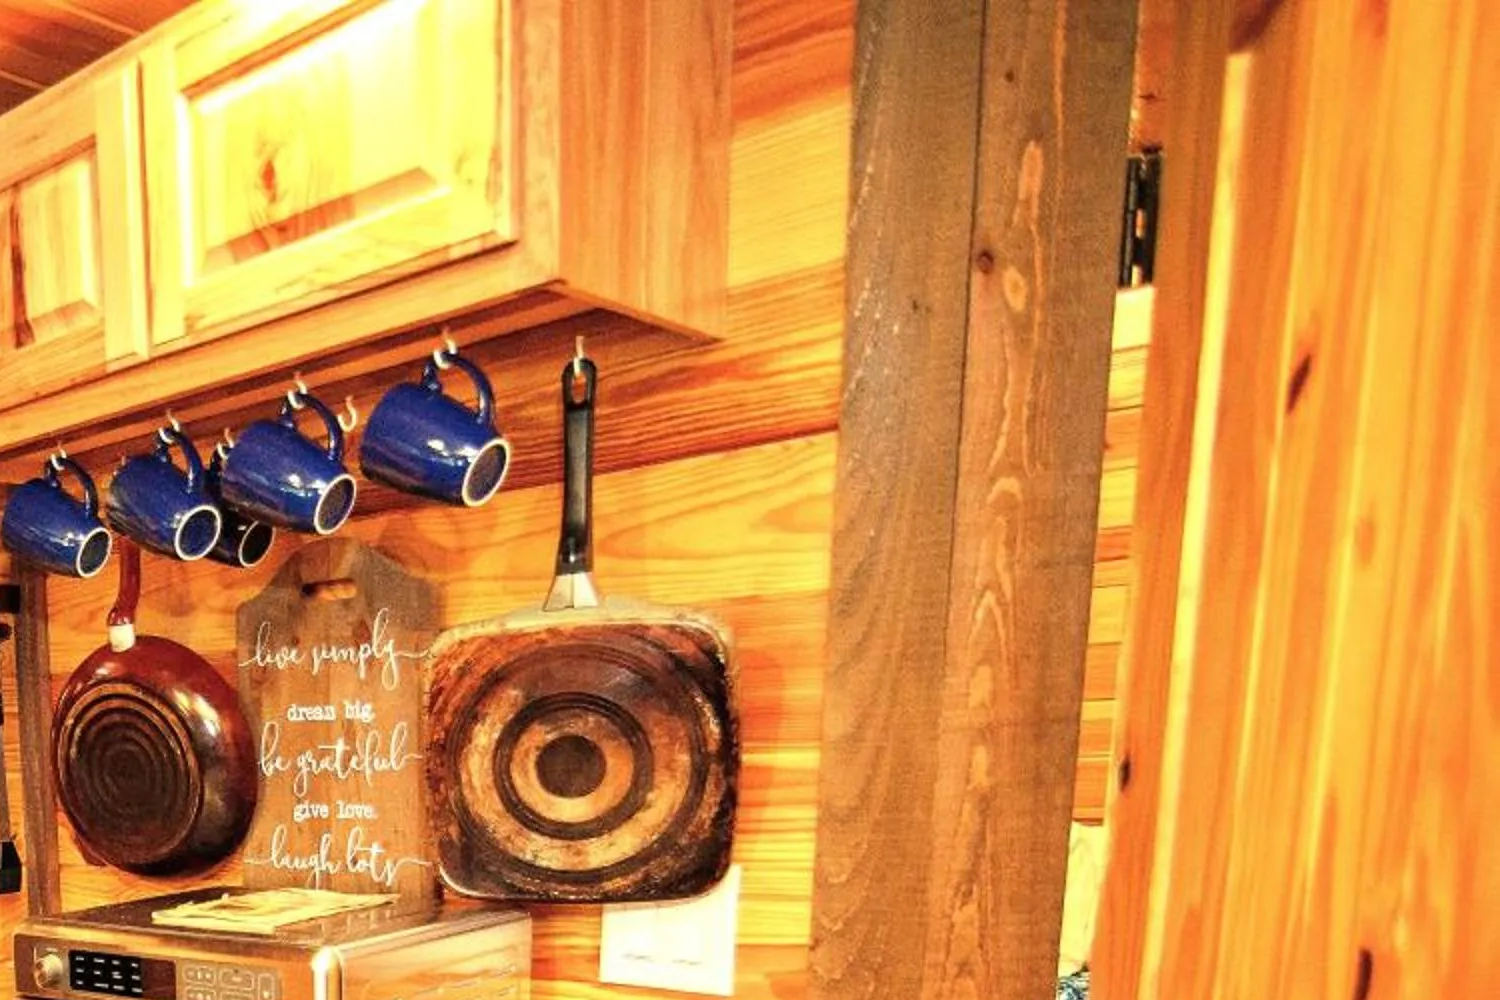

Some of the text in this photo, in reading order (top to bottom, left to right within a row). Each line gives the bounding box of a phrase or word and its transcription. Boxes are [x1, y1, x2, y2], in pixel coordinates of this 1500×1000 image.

[239, 621, 306, 669] live
[287, 703, 337, 721] dream
[259, 721, 423, 797] be grateful
[293, 800, 329, 823] give
[244, 825, 343, 890] laugh
